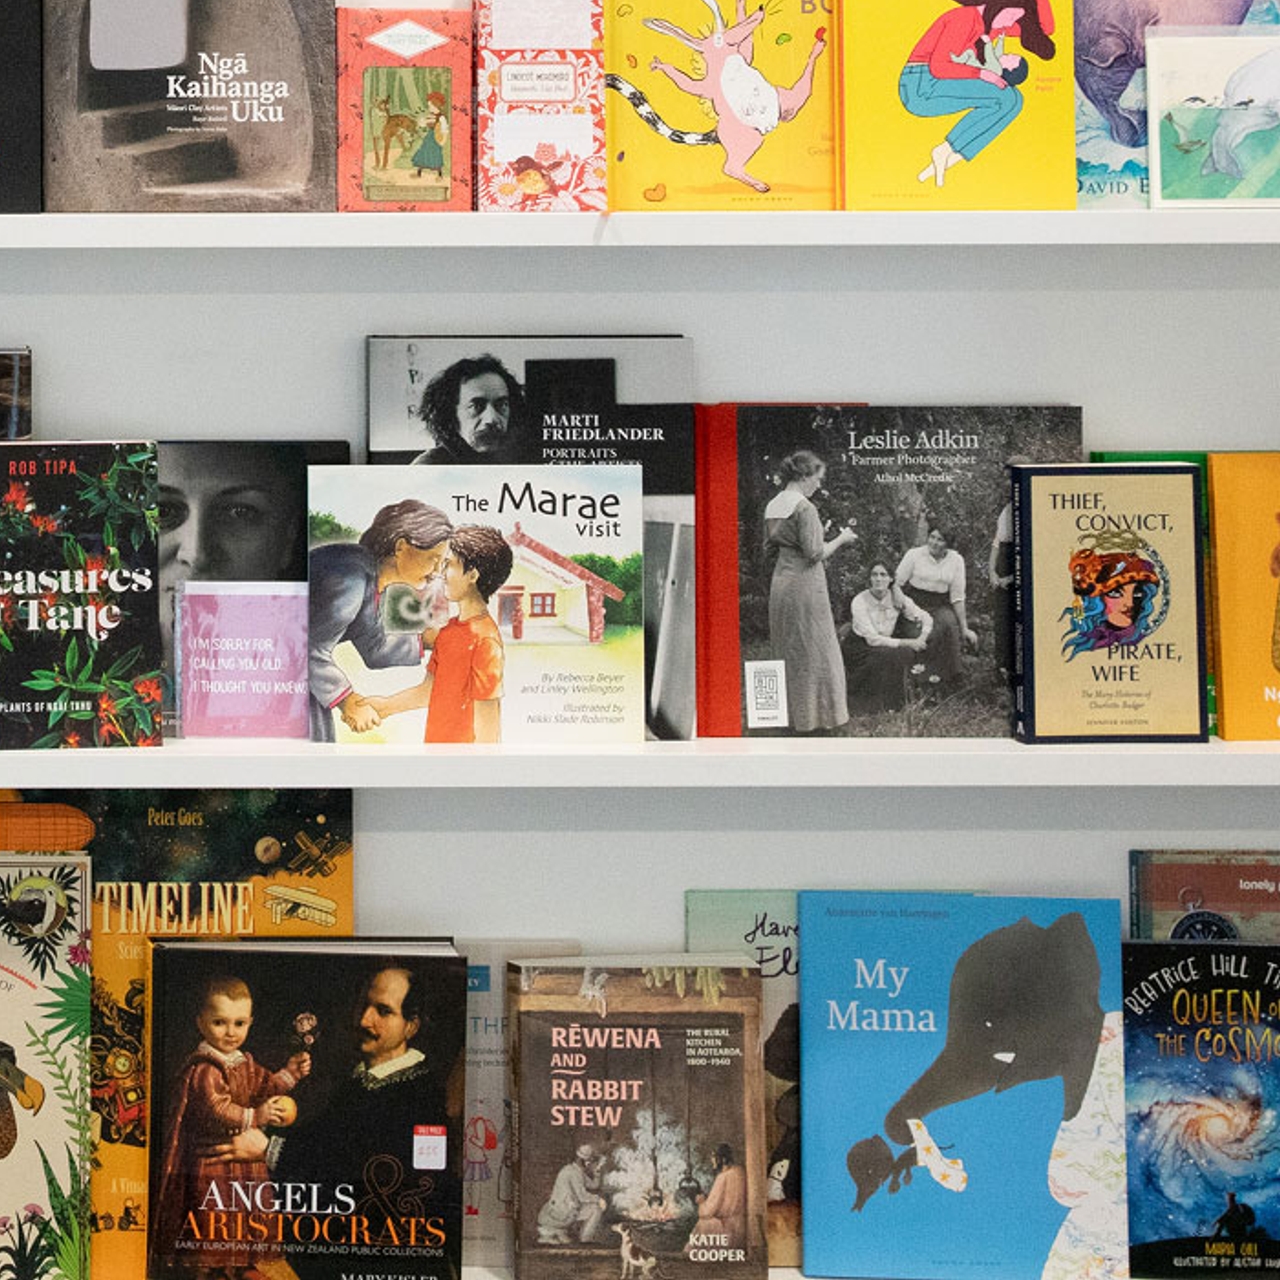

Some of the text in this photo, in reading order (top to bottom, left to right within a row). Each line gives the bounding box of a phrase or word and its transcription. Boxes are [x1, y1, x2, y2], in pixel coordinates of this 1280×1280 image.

[198, 52, 249, 81] Ngā
[166, 75, 290, 104] Kaihanga
[230, 100, 285, 122] Uku
[542, 414, 599, 427] MARTI
[542, 428, 664, 440] FRIEDLANDER
[848, 429, 979, 450] Leslie Adkin
[542, 448, 618, 458] PORTRAITS
[851, 454, 895, 465] Farmer
[8, 460, 77, 475] ROB TIPA
[874, 472, 902, 482] Athol
[452, 482, 620, 520] The Marae
[1048, 493, 1107, 512] THIEF,
[576, 522, 621, 537] visit
[1075, 514, 1174, 533] CONVICT,
[193, 638, 207, 650] I'M
[210, 638, 250, 650] SORRY
[1107, 643, 1183, 663] PIRATE,
[541, 673, 624, 683] By Rebecca Beyer
[1091, 665, 1140, 681] WIFE
[521, 685, 538, 693] and
[571, 685, 624, 695] Wellington
[34, 701, 45, 712] OF
[563, 704, 623, 714] Illustrated by
[147, 808, 204, 826] Peter Goes
[1240, 879, 1275, 891] lonely
[95, 882, 255, 935] TIMELINE
[854, 958, 909, 998] My
[1172, 988, 1261, 1025] QUEEN
[827, 1000, 937, 1032] Mama
[551, 1023, 662, 1049] RĒWENA
[686, 1029, 729, 1037] THE RURAL
[686, 1038, 721, 1047] KITCHEN
[686, 1048, 695, 1056] IN
[550, 1053, 587, 1068] AND
[551, 1080, 643, 1101] RABBIT
[550, 1105, 623, 1126] STEW
[198, 1180, 356, 1215] ANGELS
[177, 1210, 446, 1248] ARISTOCRATS
[689, 1234, 728, 1246] KATIE
[175, 1240, 443, 1257] EARLY EUROPEAN ART IN NEW ZEALAND PUBLIC COLLECTIONS
[689, 1249, 745, 1261] COOPER
